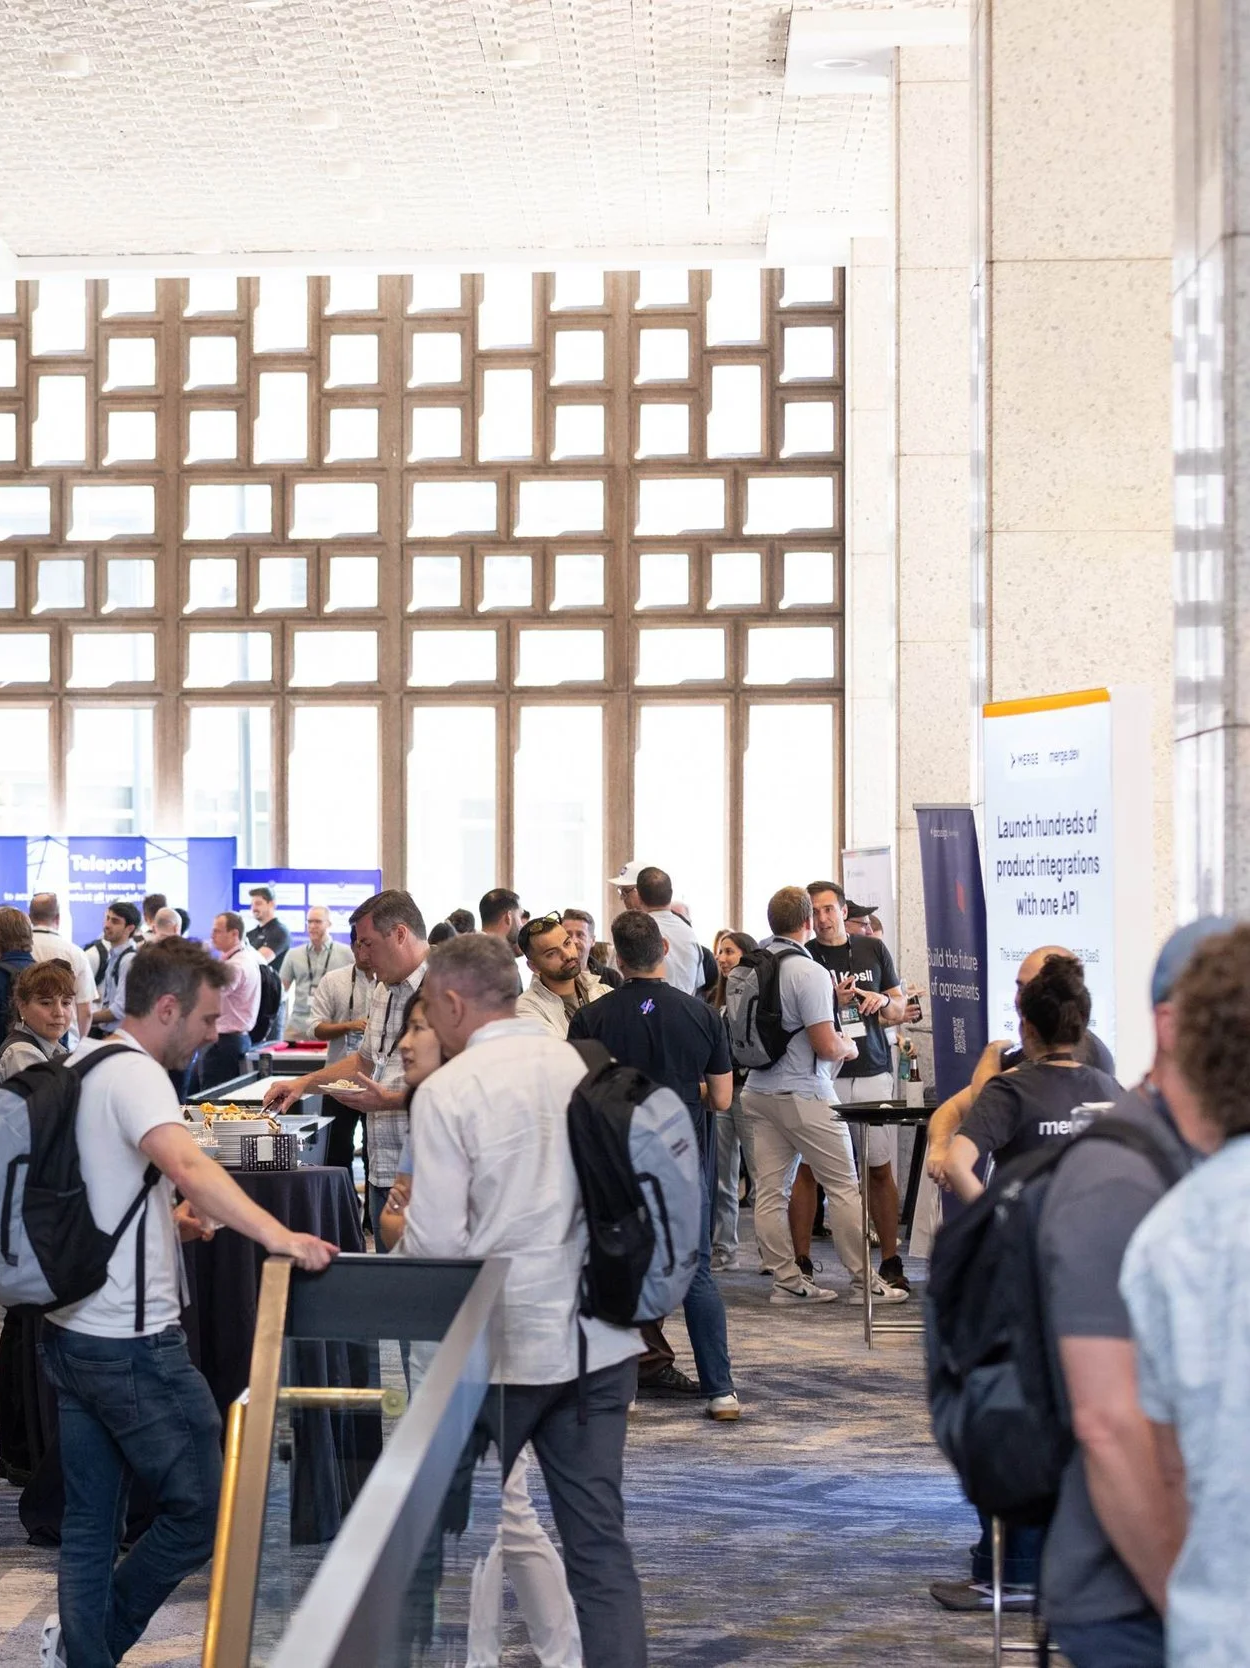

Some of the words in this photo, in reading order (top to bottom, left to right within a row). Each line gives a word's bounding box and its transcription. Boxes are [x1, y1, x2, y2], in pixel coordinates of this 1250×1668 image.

[997, 815, 1033, 839] Launch
[1034, 811, 1085, 838] hundreds
[1086, 808, 1098, 834] of
[70, 854, 144, 875] Teleport
[996, 853, 1035, 883] product
[1036, 849, 1101, 883] integrations
[1015, 890, 1038, 916] with
[1039, 897, 1059, 916] one
[1060, 889, 1080, 916] API
